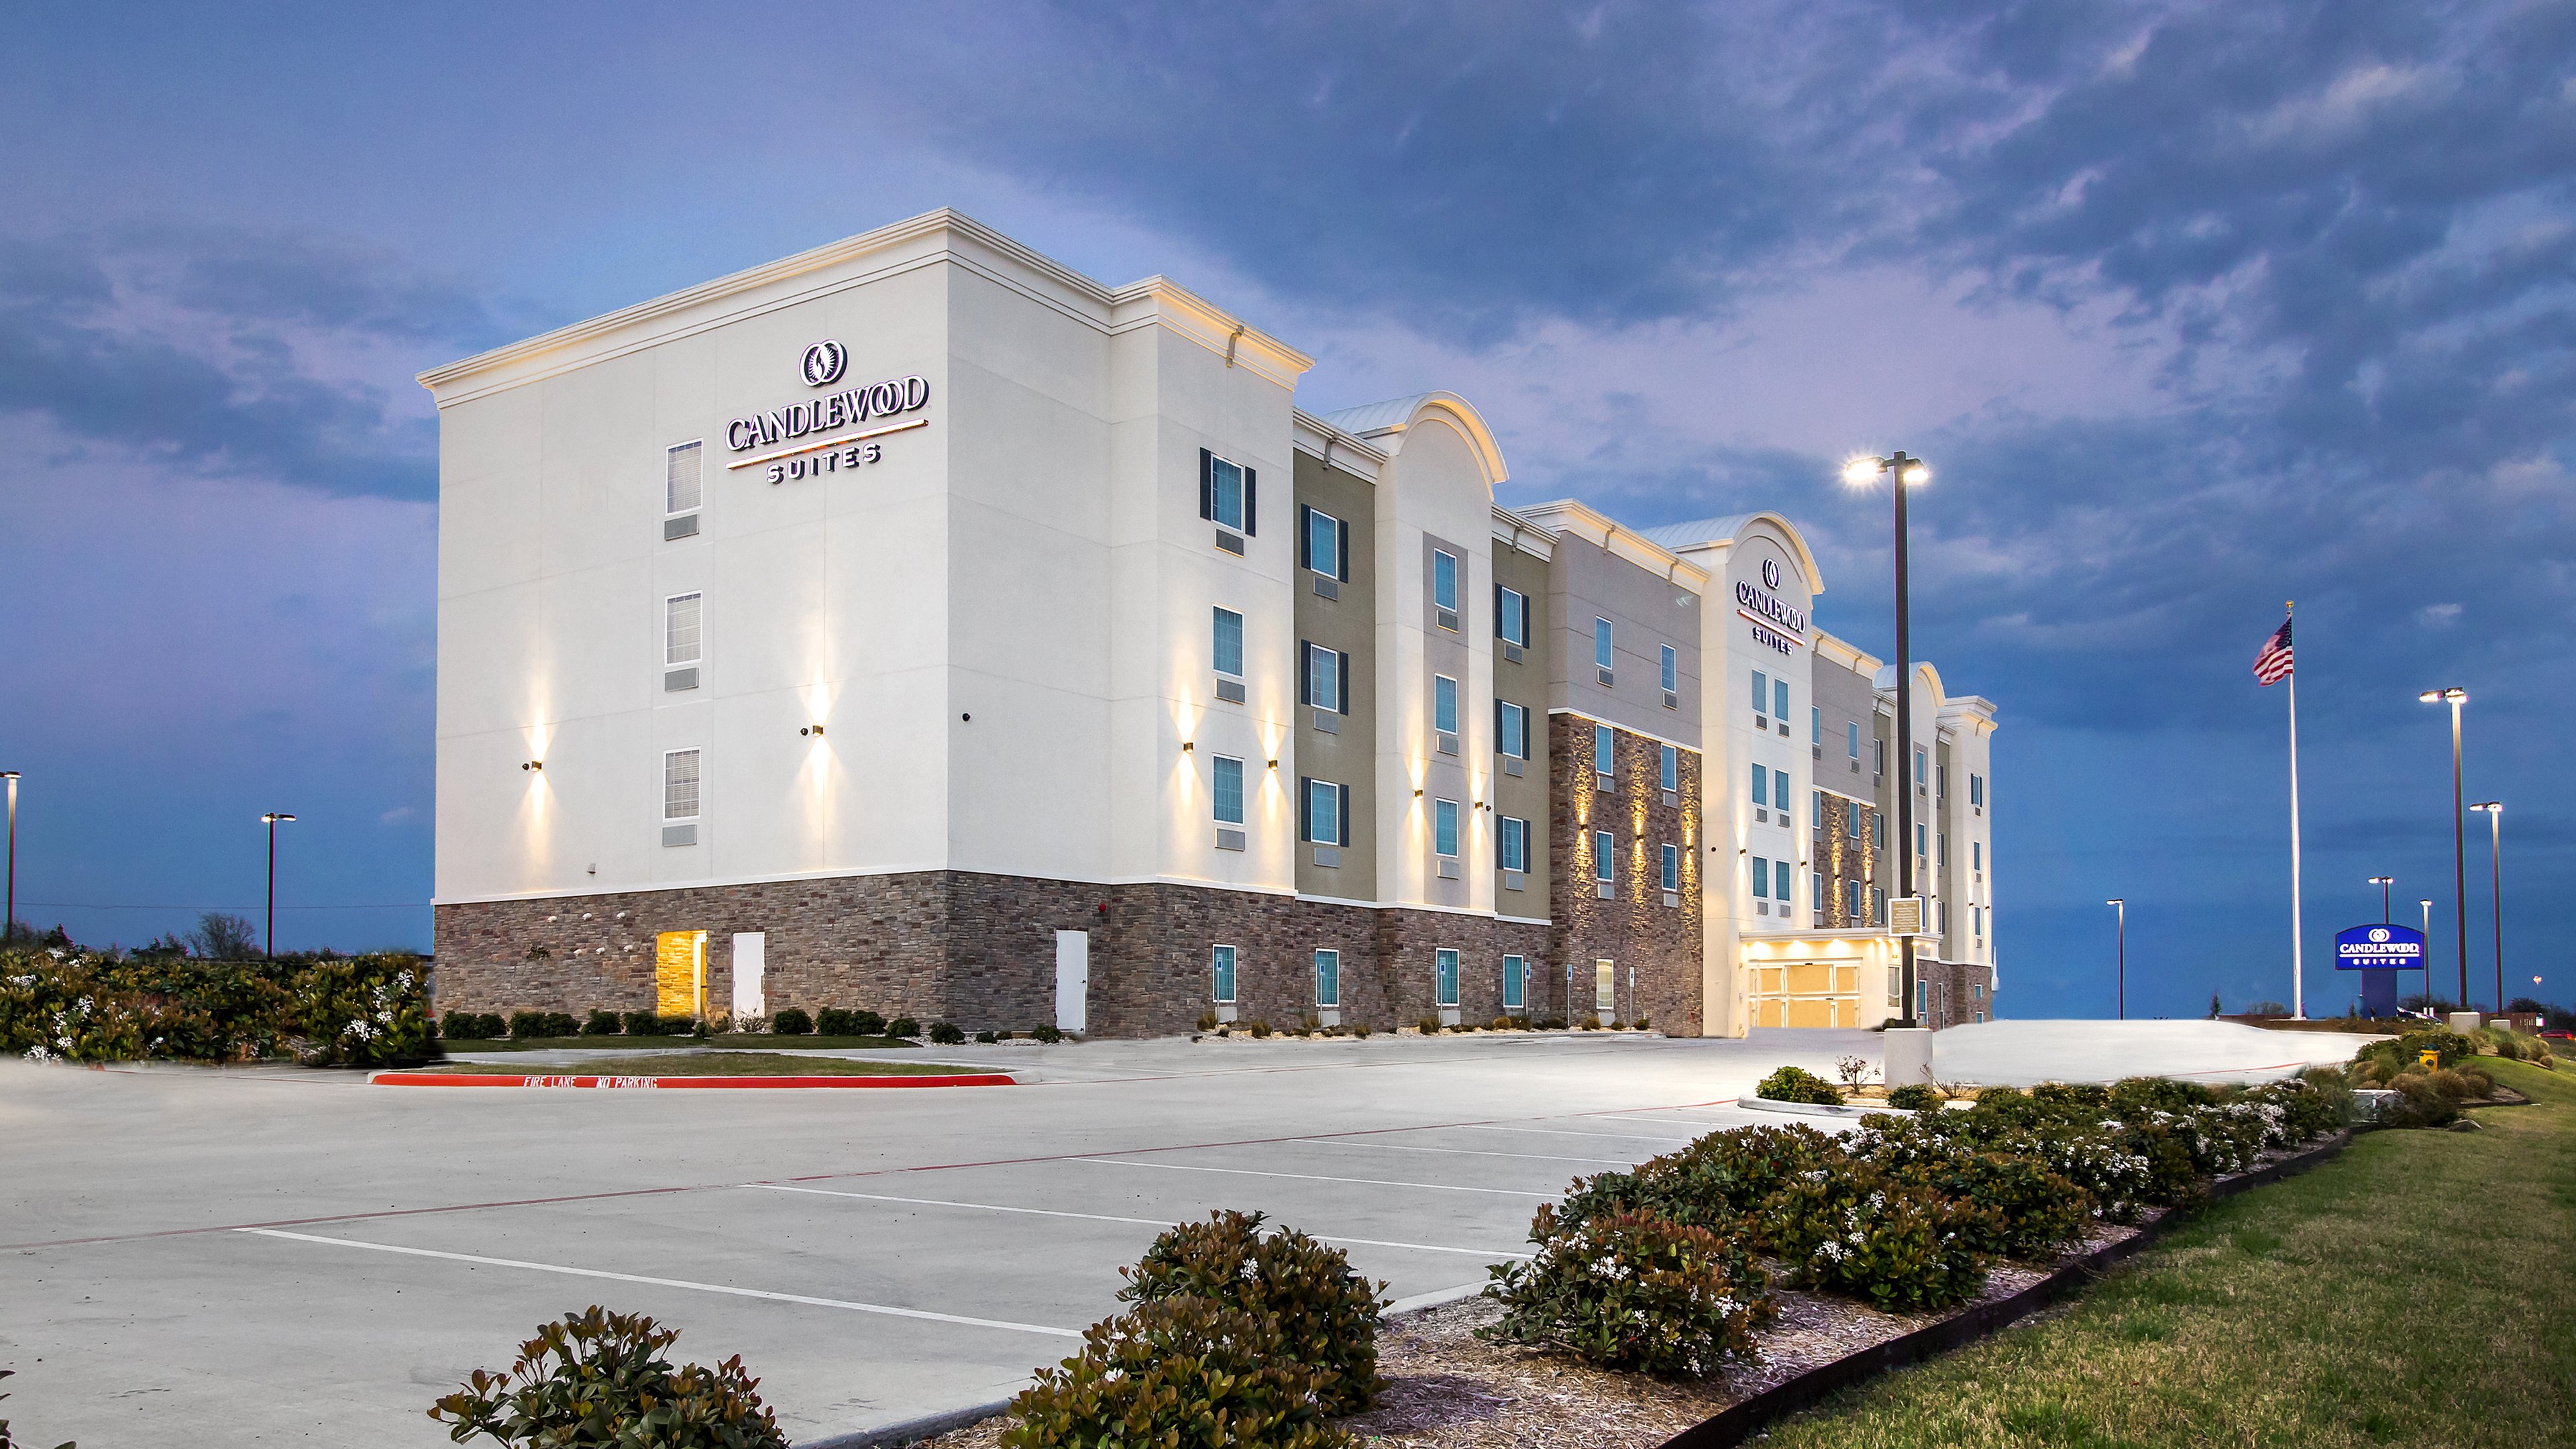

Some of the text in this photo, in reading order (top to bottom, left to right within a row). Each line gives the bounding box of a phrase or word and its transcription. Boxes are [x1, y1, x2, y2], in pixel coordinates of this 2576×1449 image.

[724, 374, 930, 451] CANDLEWOOD
[767, 443, 881, 484] SUITES
[1736, 580, 1807, 633] CANDLEWOOD
[1752, 626, 1793, 655] SUITES
[2339, 943, 2420, 953] CANDLEWOOD
[523, 1076, 657, 1089] FIRE LANE NO PARKING
